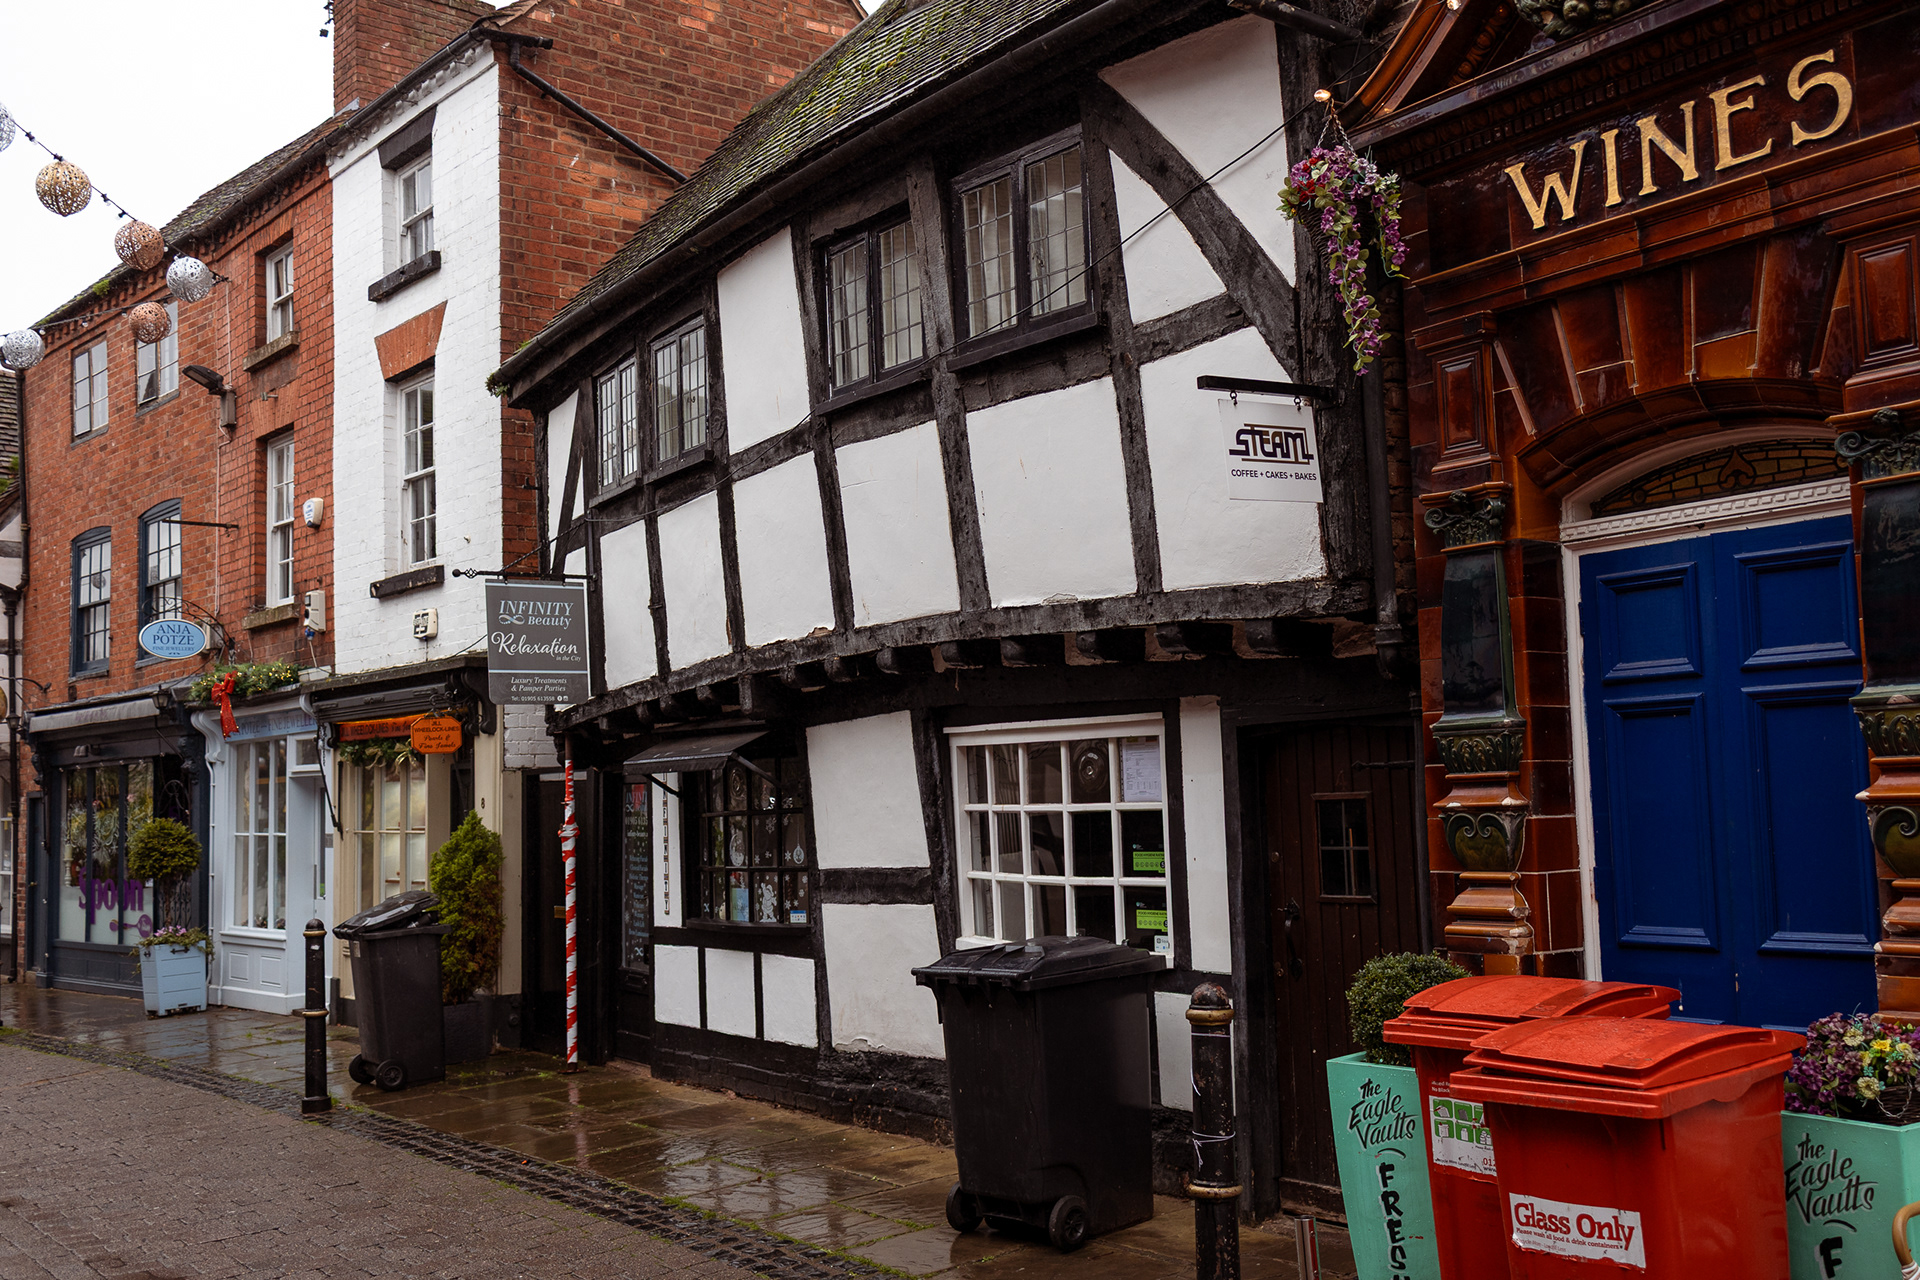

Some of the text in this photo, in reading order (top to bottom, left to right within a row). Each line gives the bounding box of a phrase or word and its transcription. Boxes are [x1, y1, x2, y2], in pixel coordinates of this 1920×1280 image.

[1504, 49, 1853, 230] WINES
[1229, 424, 1314, 462] STEAM
[1231, 469, 1258, 478] COFFEE
[1265, 471, 1288, 479] CAKES
[1294, 472, 1317, 481] BAKES
[499, 600, 574, 616] INFINITY
[157, 624, 191, 634] ANJA
[528, 616, 571, 629] Beauty
[153, 634, 194, 645] POTZE
[491, 631, 578, 657] Relaxation
[511, 677, 532, 685] Luxury
[519, 685, 542, 693] Pamper
[1350, 1087, 1405, 1130] Eagle
[1355, 1112, 1420, 1149] Vaults
[1784, 1150, 1855, 1201] Eagle
[1795, 1175, 1878, 1224] Vaults
[1377, 1162, 1411, 1280] FRES
[1514, 1203, 1634, 1251] Glass Only
[1516, 1227, 1533, 1236] Please
[1533, 1231, 1545, 1239] wash
